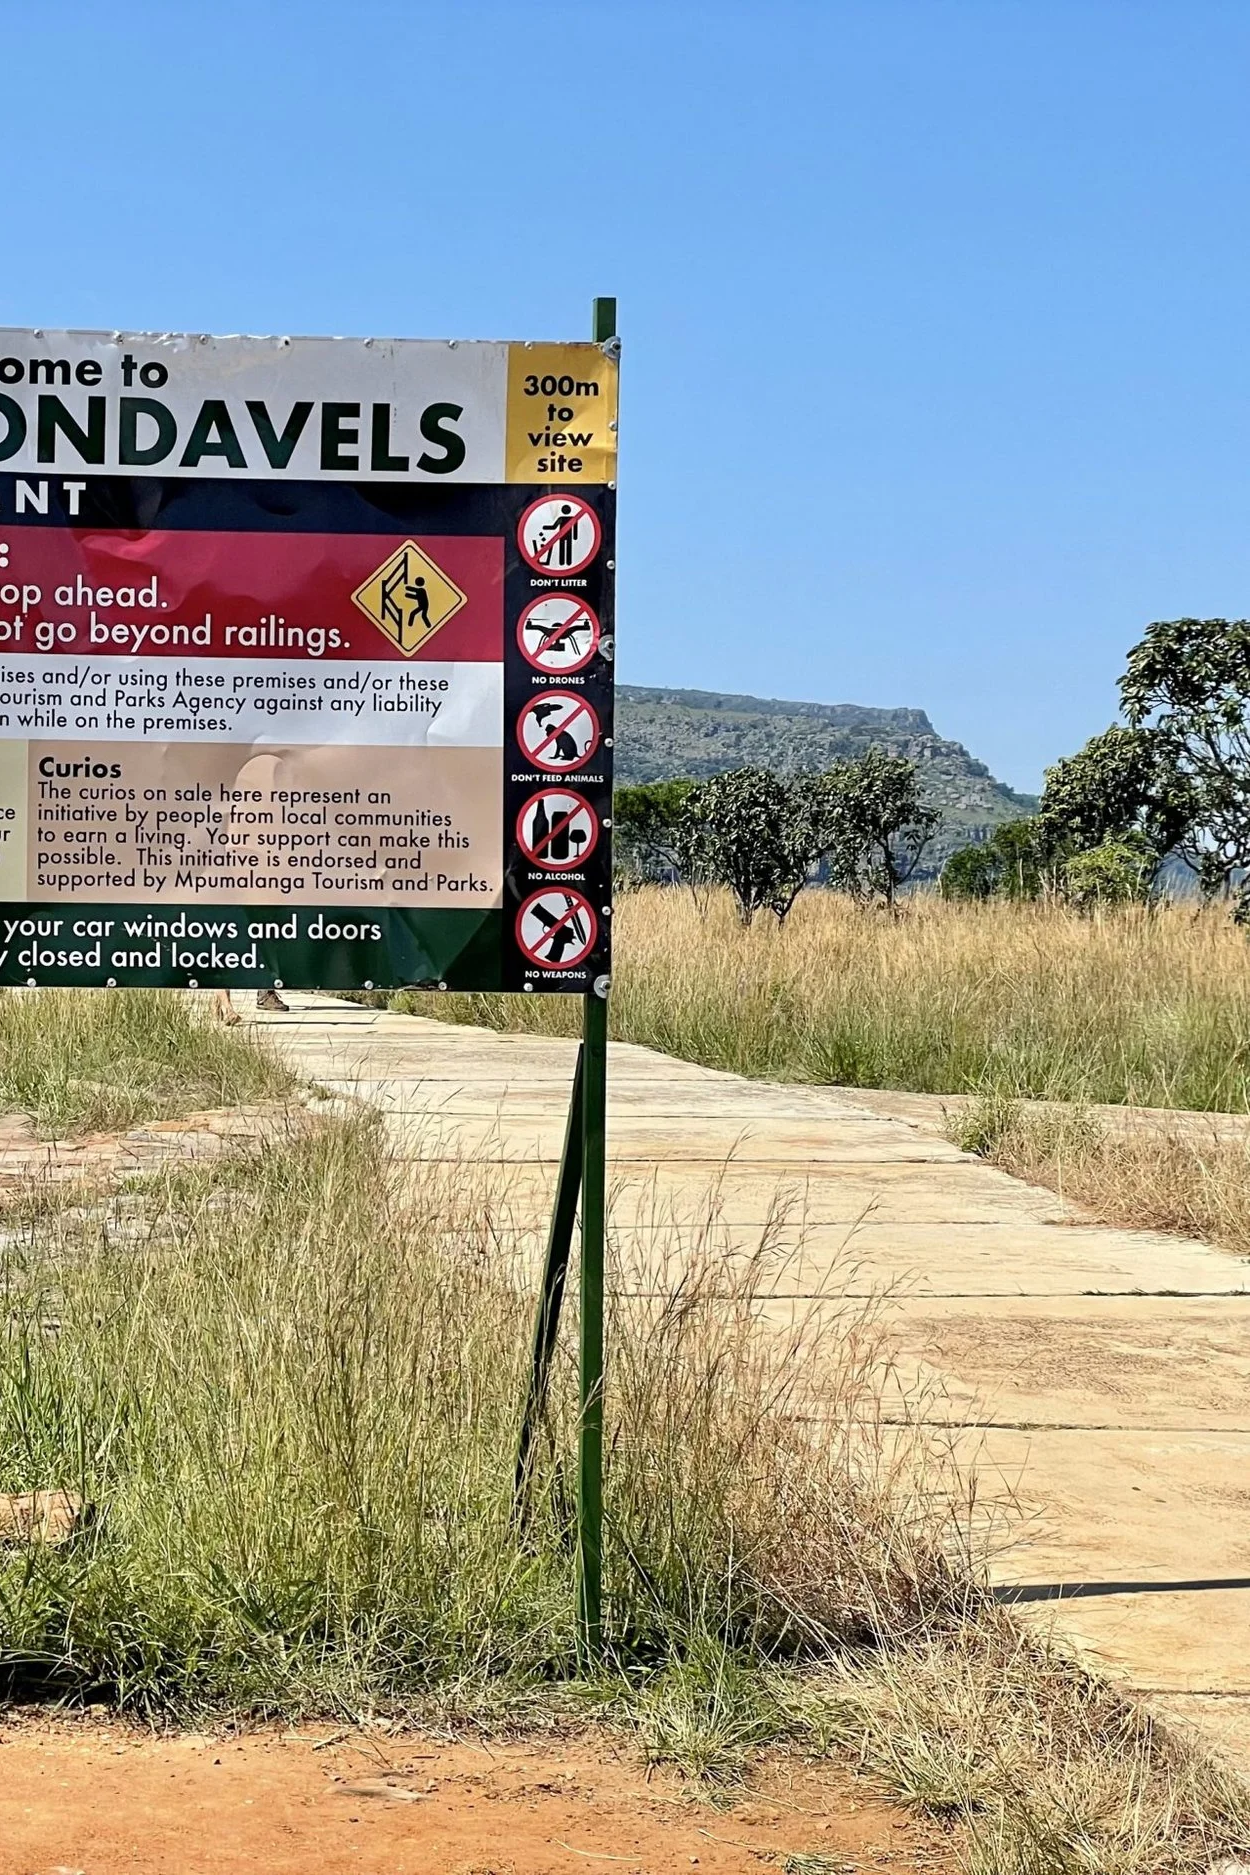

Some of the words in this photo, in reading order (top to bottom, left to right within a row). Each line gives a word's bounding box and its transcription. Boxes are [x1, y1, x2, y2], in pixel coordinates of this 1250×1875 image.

[120, 353, 169, 389] to
[523, 374, 598, 397] 300m
[547, 404, 573, 422] to
[527, 425, 593, 448] view
[536, 451, 582, 473] site
[54, 573, 167, 609] ahead.
[561, 578, 587, 587] LITTER
[35, 619, 76, 651] go
[90, 610, 210, 653] beyond
[225, 613, 350, 657] railings.
[42, 661, 111, 688] and/or
[118, 663, 167, 692] using
[175, 663, 225, 687] these
[233, 665, 316, 693] premises
[323, 667, 392, 694] and/or
[399, 668, 448, 691] these
[531, 676, 547, 685] NO
[549, 676, 585, 685] DRONES
[70, 685, 106, 706] and
[115, 686, 165, 707] Parks
[172, 687, 246, 715] Agency
[253, 689, 323, 715] against
[330, 696, 365, 717] any
[373, 690, 442, 718] liability
[38, 756, 121, 779] Curios
[542, 774, 562, 782] FEED
[564, 774, 604, 783] ANIMALS
[38, 802, 117, 823] initiative
[125, 803, 148, 829] by
[156, 804, 222, 830] people
[229, 804, 273, 825] from
[281, 805, 326, 825] local
[334, 807, 451, 827] communities
[37, 846, 121, 871] possible.
[136, 846, 172, 866] This
[179, 847, 258, 867] initiative
[267, 848, 280, 868] is
[287, 848, 376, 869] endorsed
[384, 849, 421, 869] and
[37, 868, 135, 893] supported
[143, 869, 166, 894] by
[174, 869, 304, 896] Mpumalanga
[312, 870, 384, 891] Tourism
[391, 871, 428, 891] and
[437, 872, 493, 892] Parks.
[527, 872, 543, 880] NO
[544, 872, 585, 880] ALCOHOL
[3, 918, 63, 943] your
[72, 919, 115, 937] car
[123, 912, 238, 938] windows
[247, 913, 297, 939] and
[307, 914, 381, 940] doors
[17, 940, 100, 967] closed
[111, 942, 160, 967] and
[171, 942, 264, 969] locked.
[524, 970, 540, 978] NO
[541, 970, 586, 978] WEAPONS
